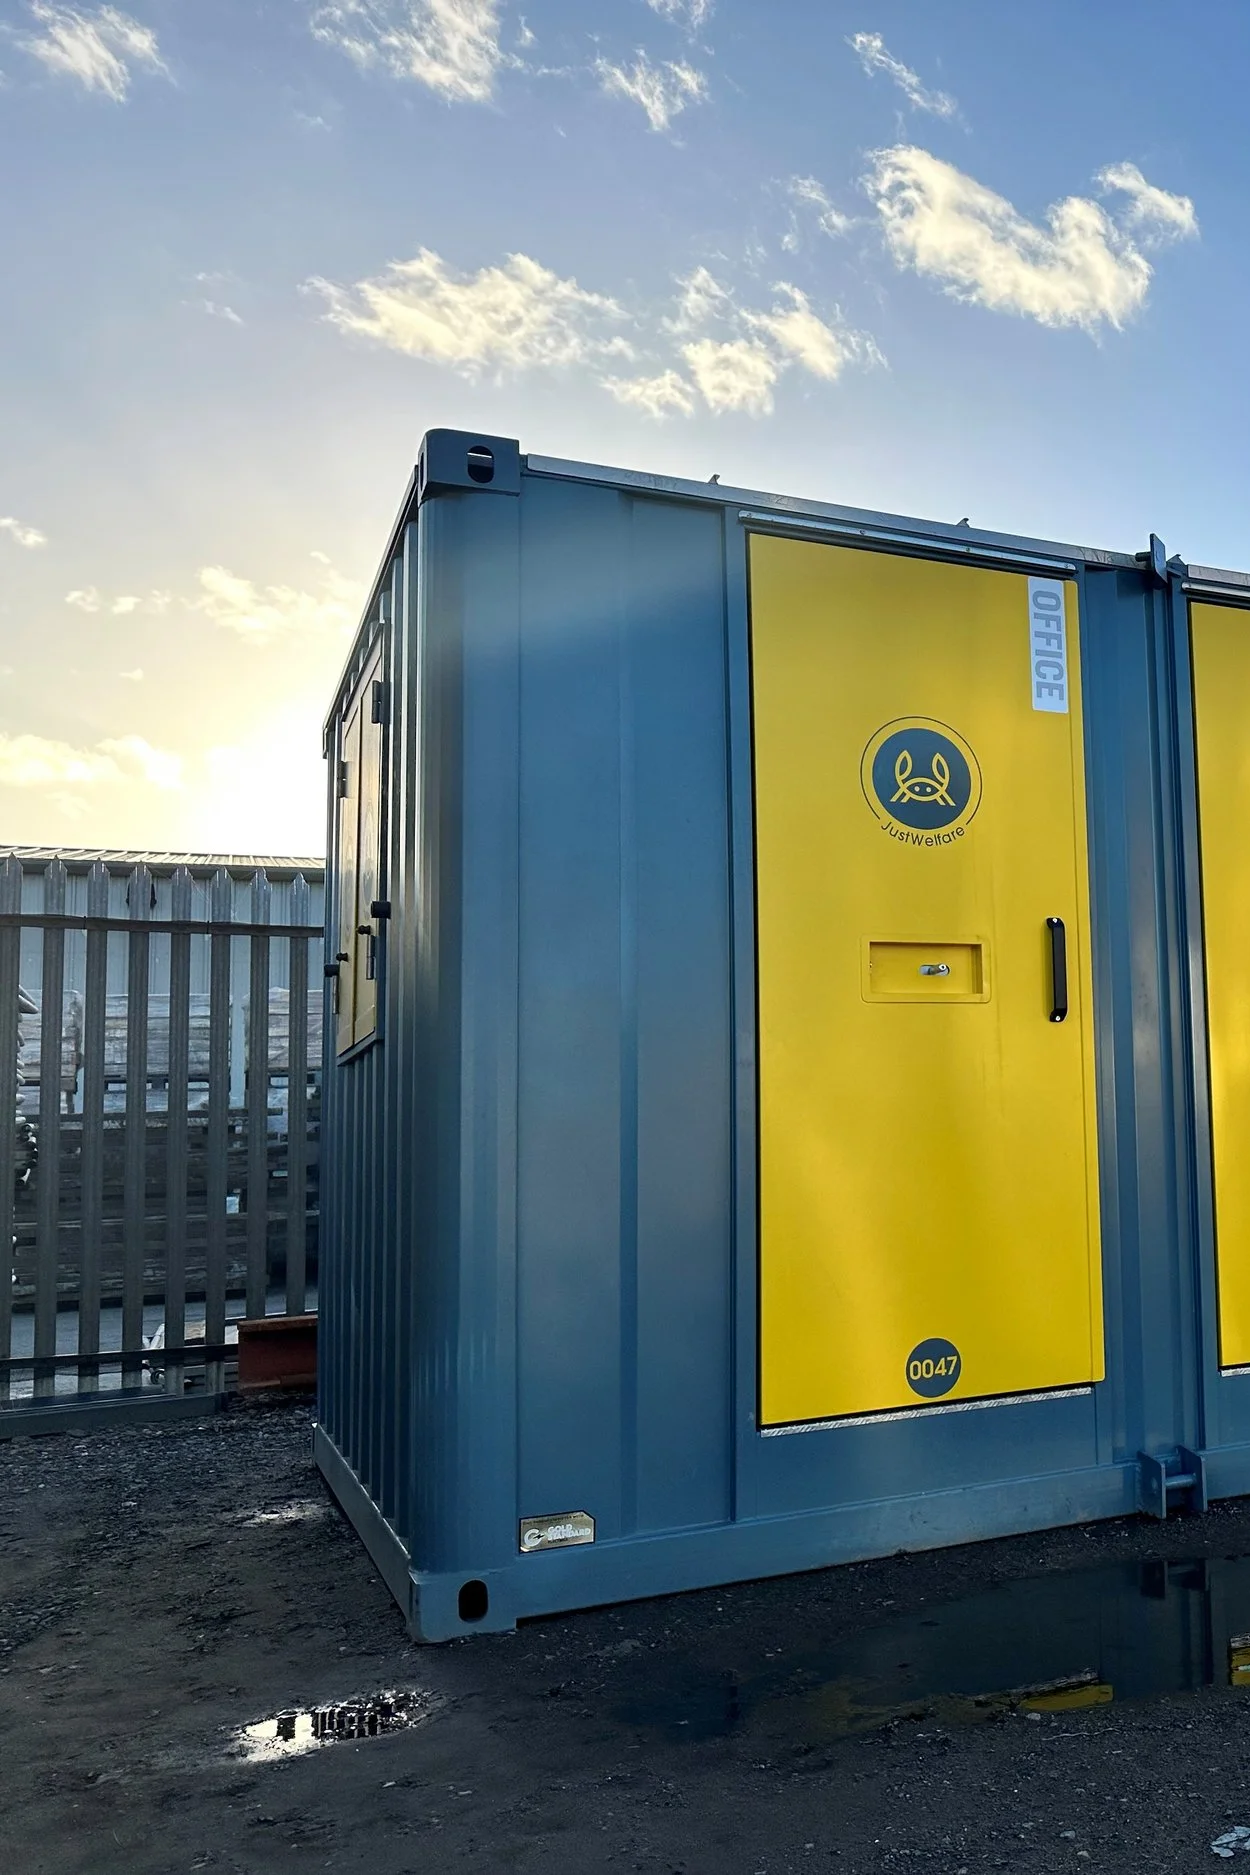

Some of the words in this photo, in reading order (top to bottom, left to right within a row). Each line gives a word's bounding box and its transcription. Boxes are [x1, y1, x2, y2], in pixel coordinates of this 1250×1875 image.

[1032, 590, 1065, 700] OFFICE
[881, 821, 965, 846] JustWelfare
[909, 1355, 958, 1380] 0047
